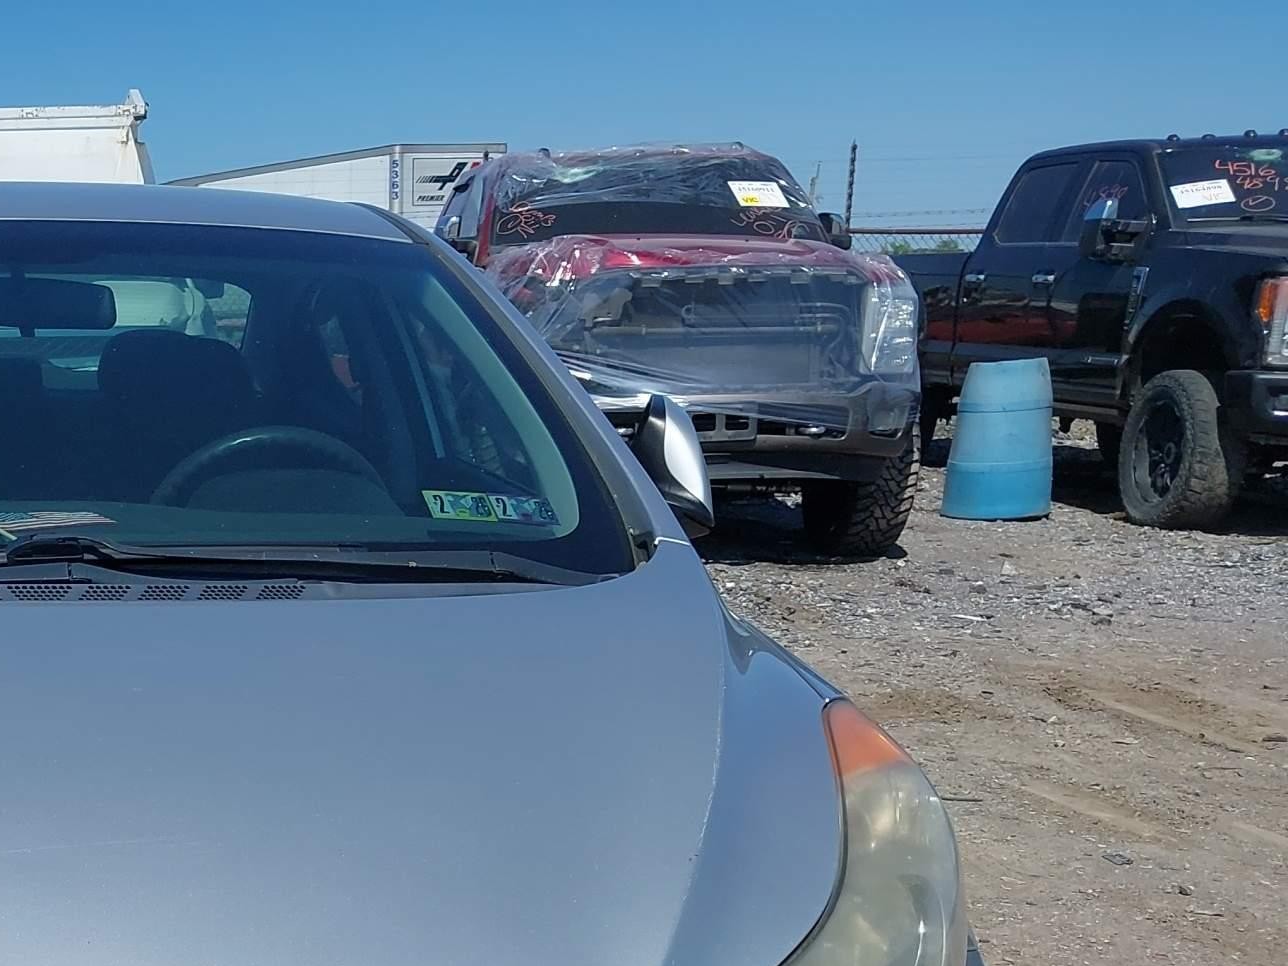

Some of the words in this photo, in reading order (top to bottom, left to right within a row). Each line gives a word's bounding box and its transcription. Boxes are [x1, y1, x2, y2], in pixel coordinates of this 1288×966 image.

[1215, 159, 1276, 176] 4516
[392, 159, 400, 200] 5363
[416, 194, 446, 202] PREMIER
